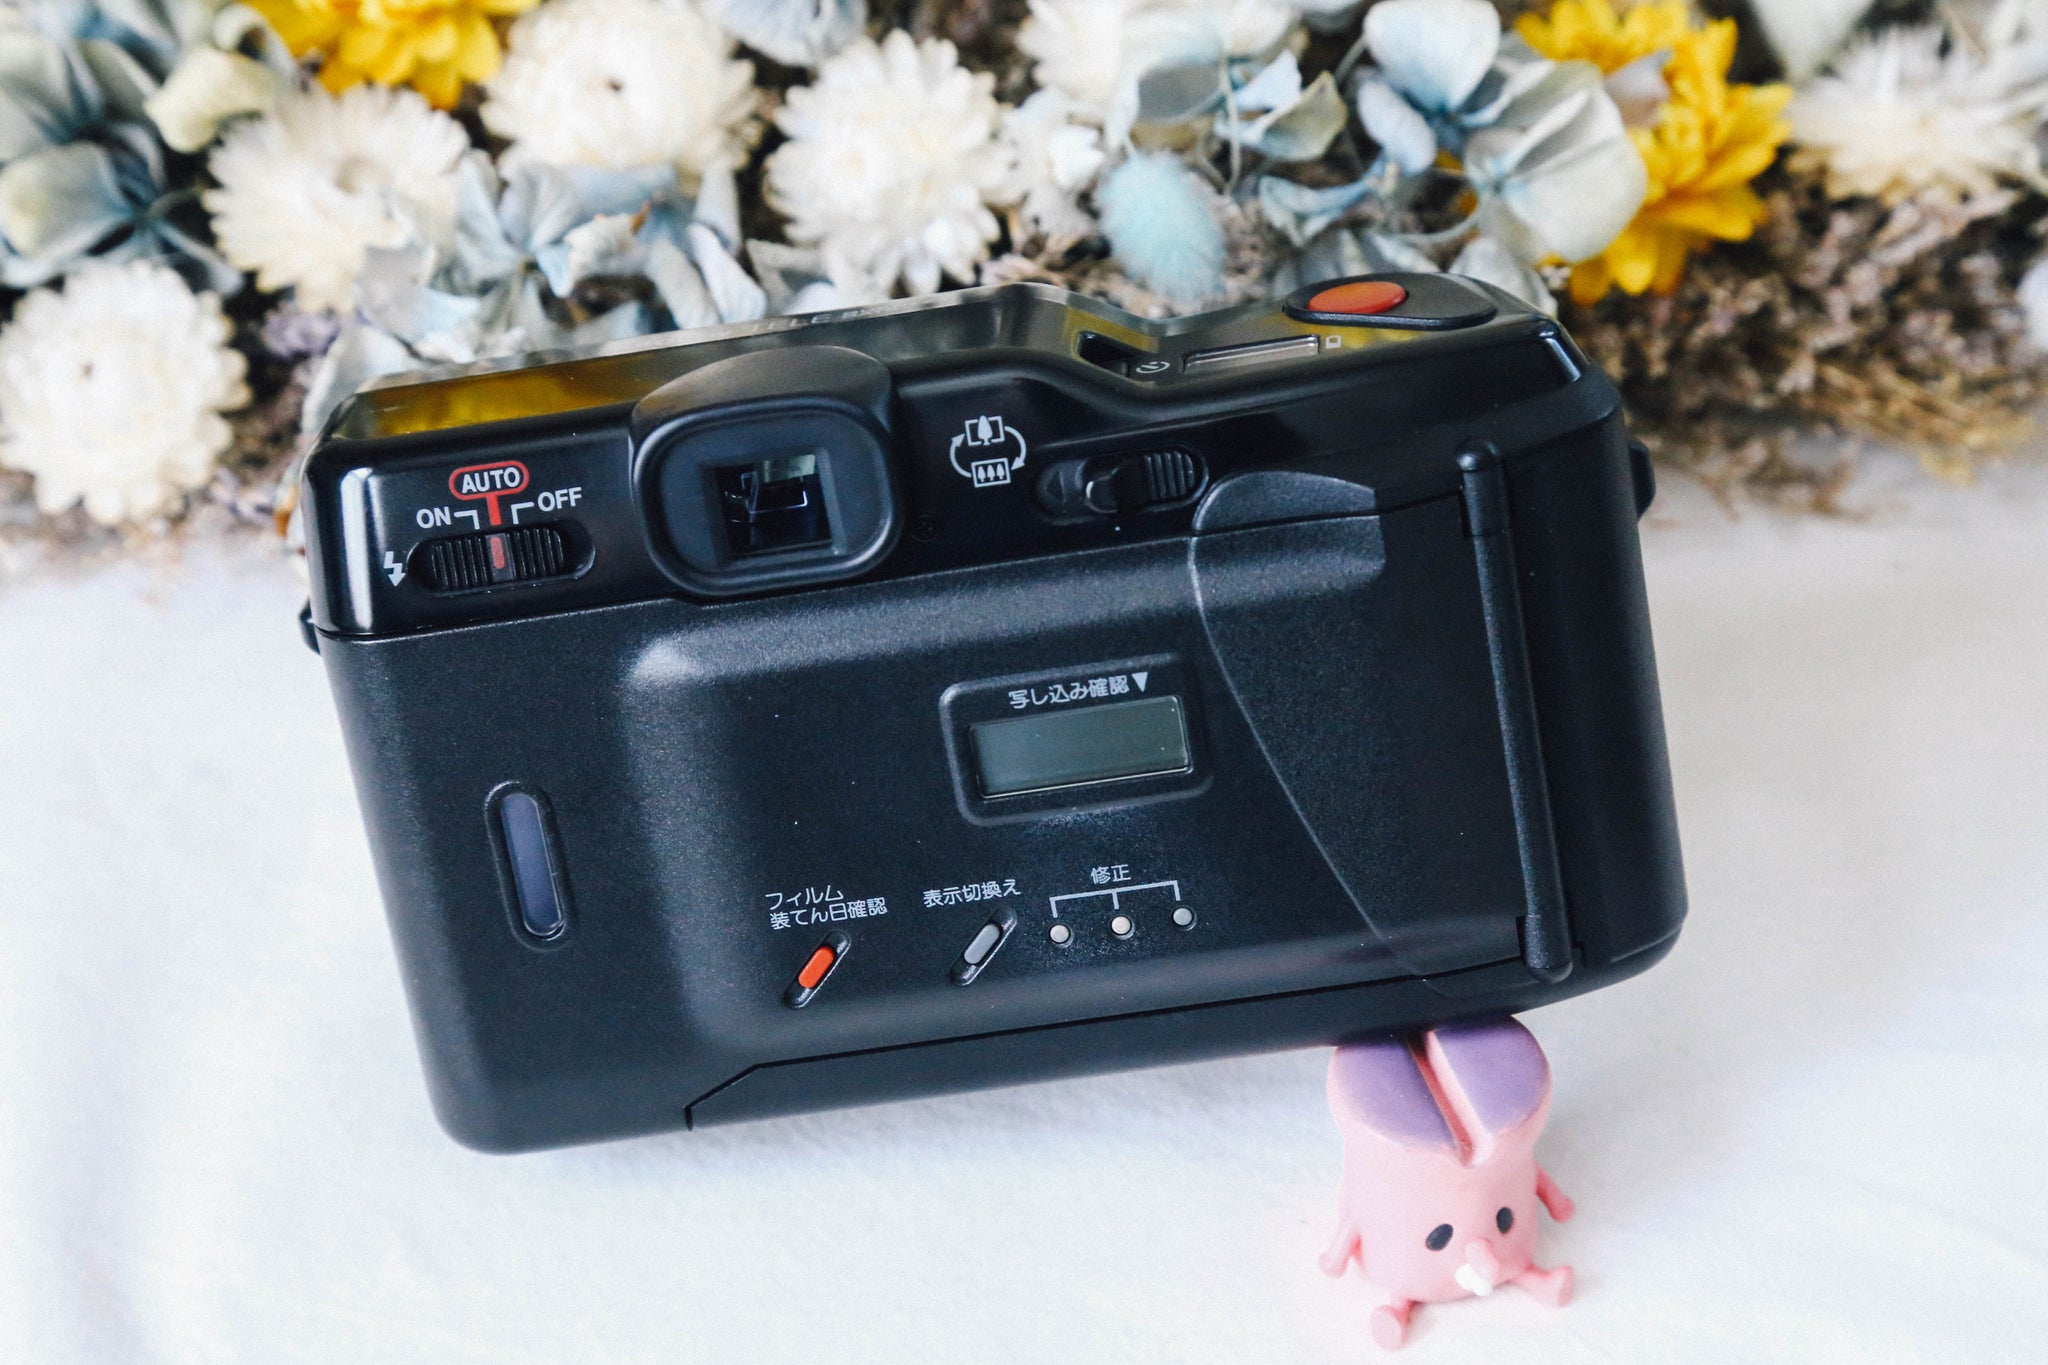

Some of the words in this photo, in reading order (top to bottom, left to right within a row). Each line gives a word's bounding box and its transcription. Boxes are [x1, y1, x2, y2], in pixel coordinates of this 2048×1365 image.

[461, 467, 521, 494] AUTO
[537, 486, 582, 512] OFF
[416, 506, 452, 529] ON
[1008, 674, 1130, 709] 写し込み確認
[1090, 864, 1132, 884] 修正
[765, 885, 844, 910] フィルム
[922, 878, 1021, 908] 表示切換え
[770, 897, 888, 930] 装てん日確認
